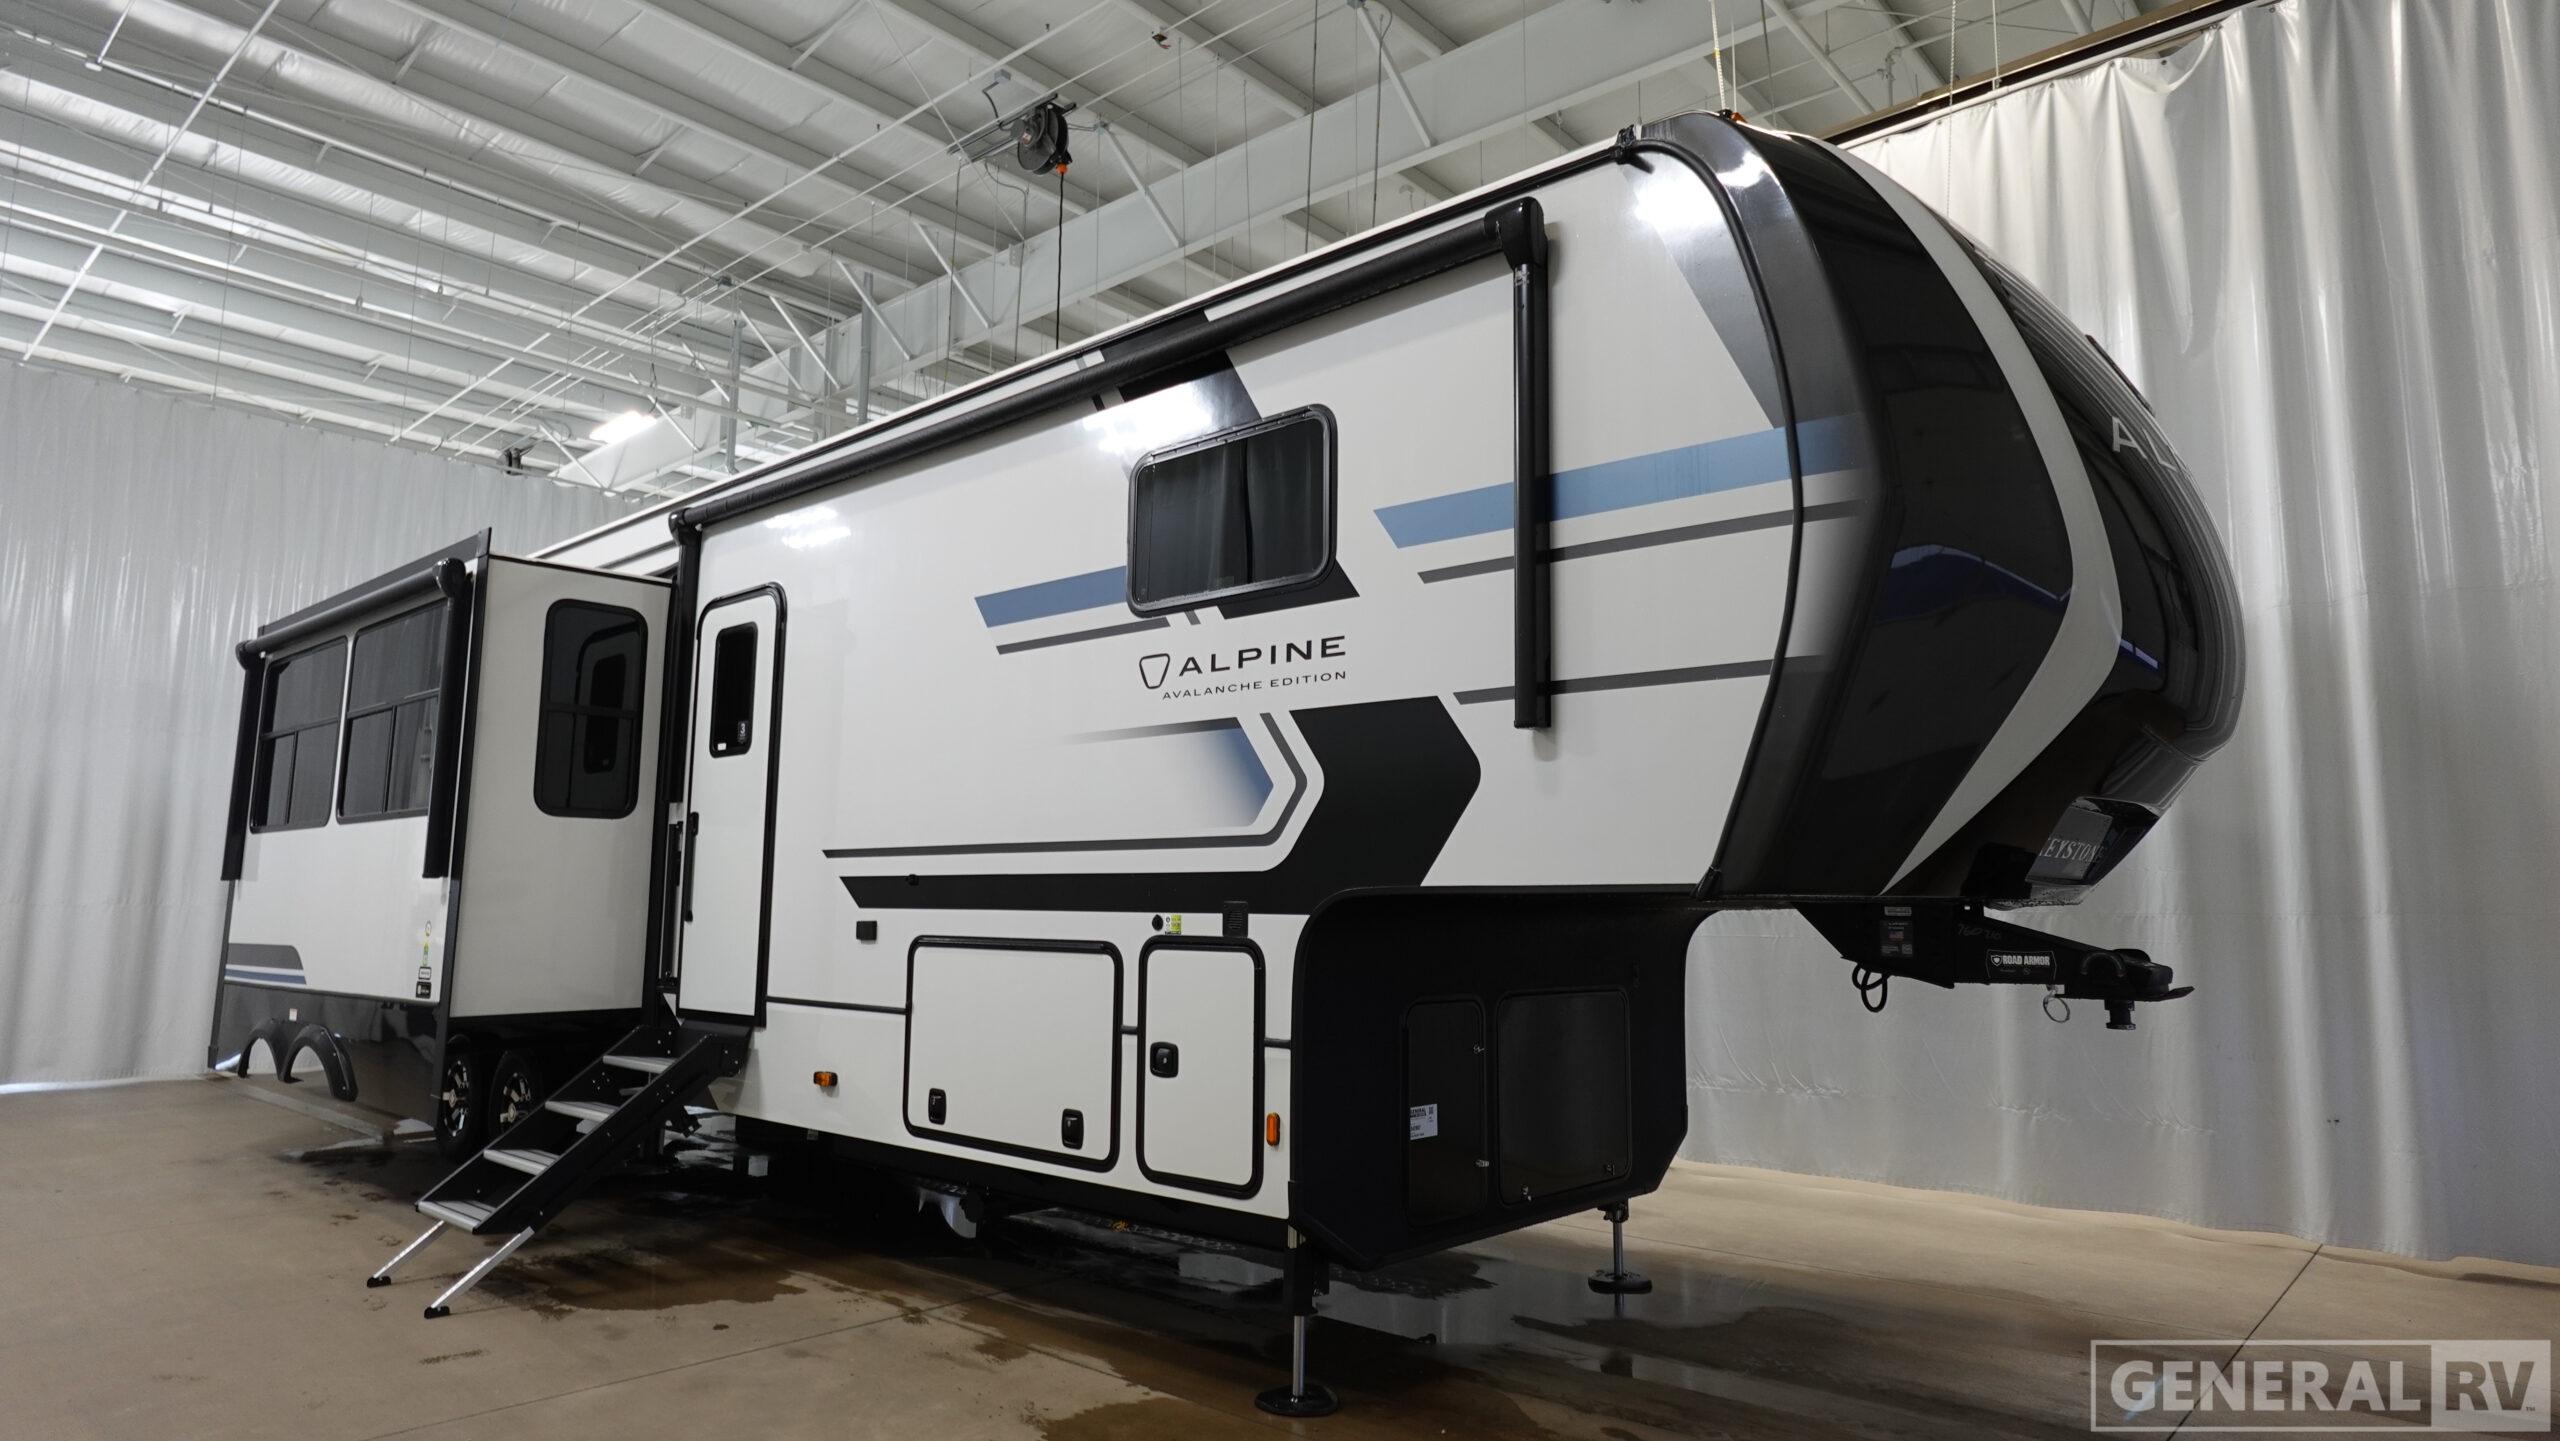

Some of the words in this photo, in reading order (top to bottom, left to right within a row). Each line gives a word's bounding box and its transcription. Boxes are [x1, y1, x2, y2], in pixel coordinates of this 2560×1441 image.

[1179, 635, 1346, 677] ALPINE
[1162, 681, 1262, 700] AVALANCHE
[1270, 671, 1346, 687] EDITION
[2002, 955, 2022, 965] ROAD
[2023, 956, 2050, 966] ARMOR
